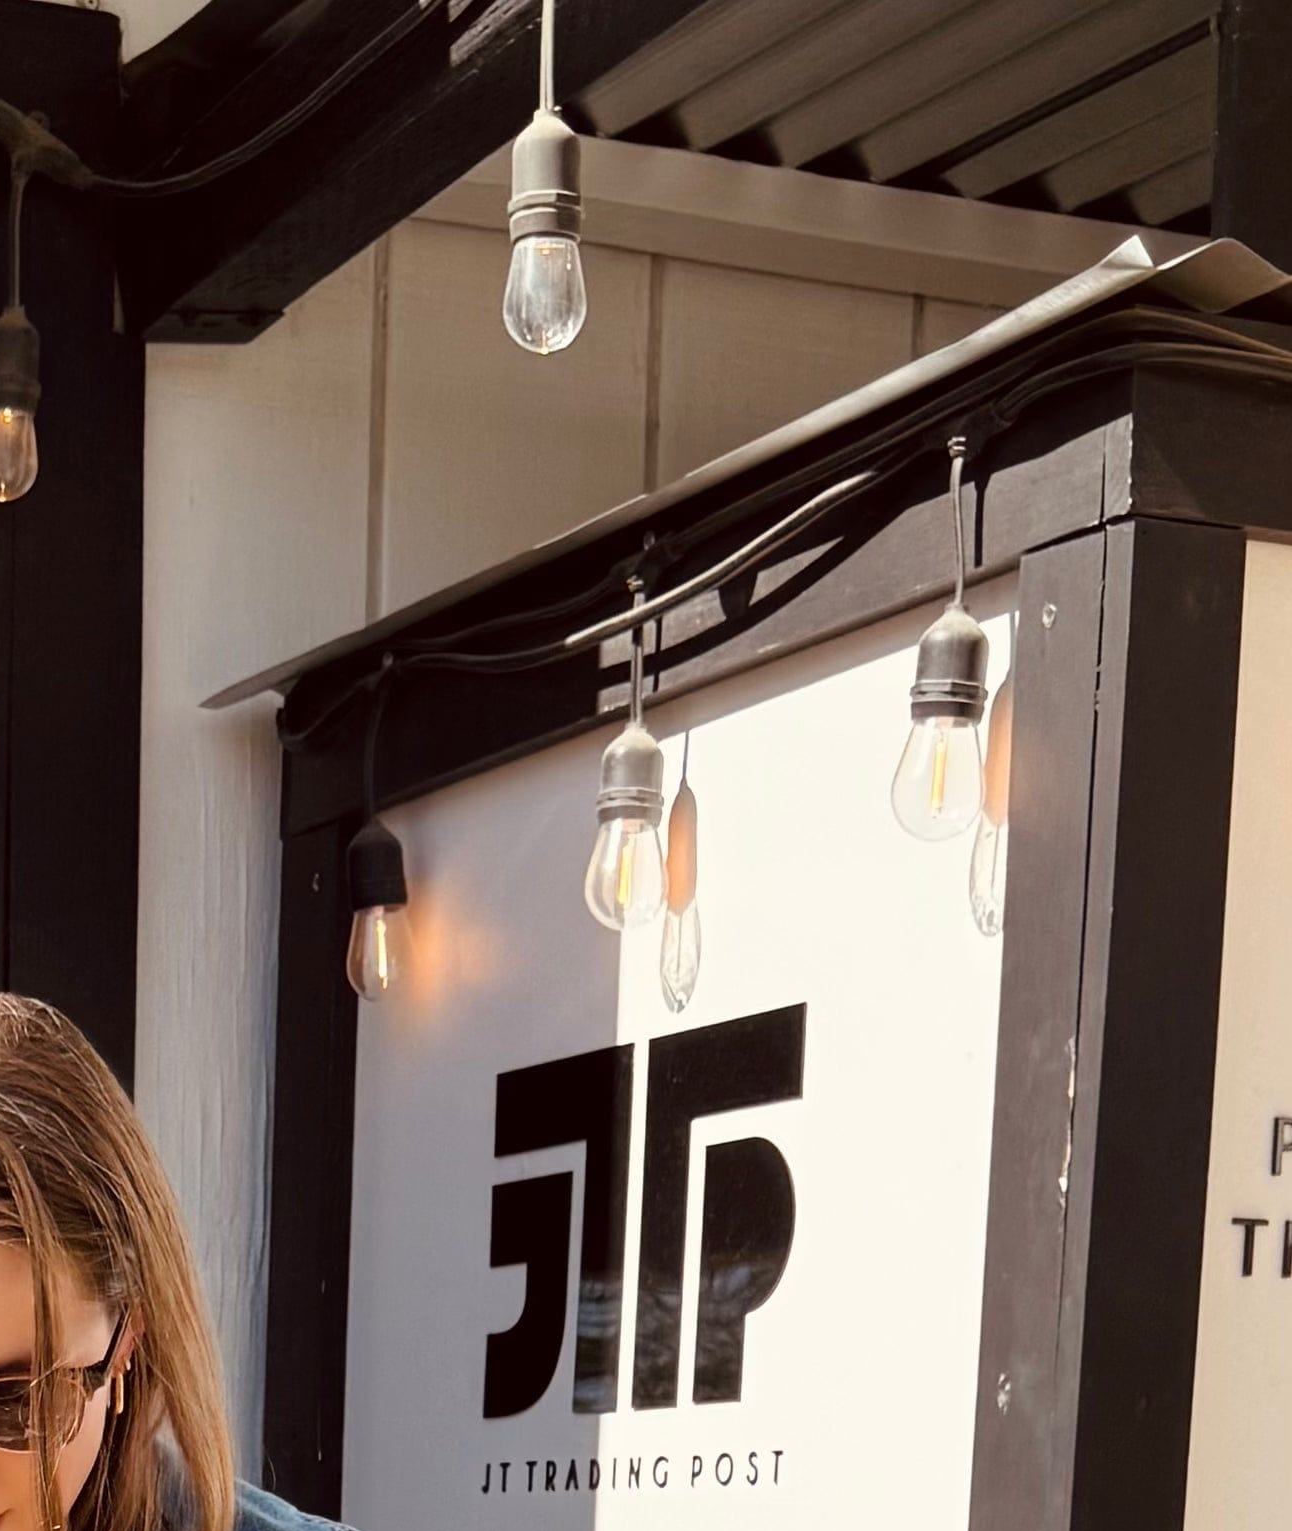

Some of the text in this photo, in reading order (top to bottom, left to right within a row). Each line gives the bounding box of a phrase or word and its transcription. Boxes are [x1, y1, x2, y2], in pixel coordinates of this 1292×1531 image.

[481, 1449, 783, 1494] JT TRADING POST
